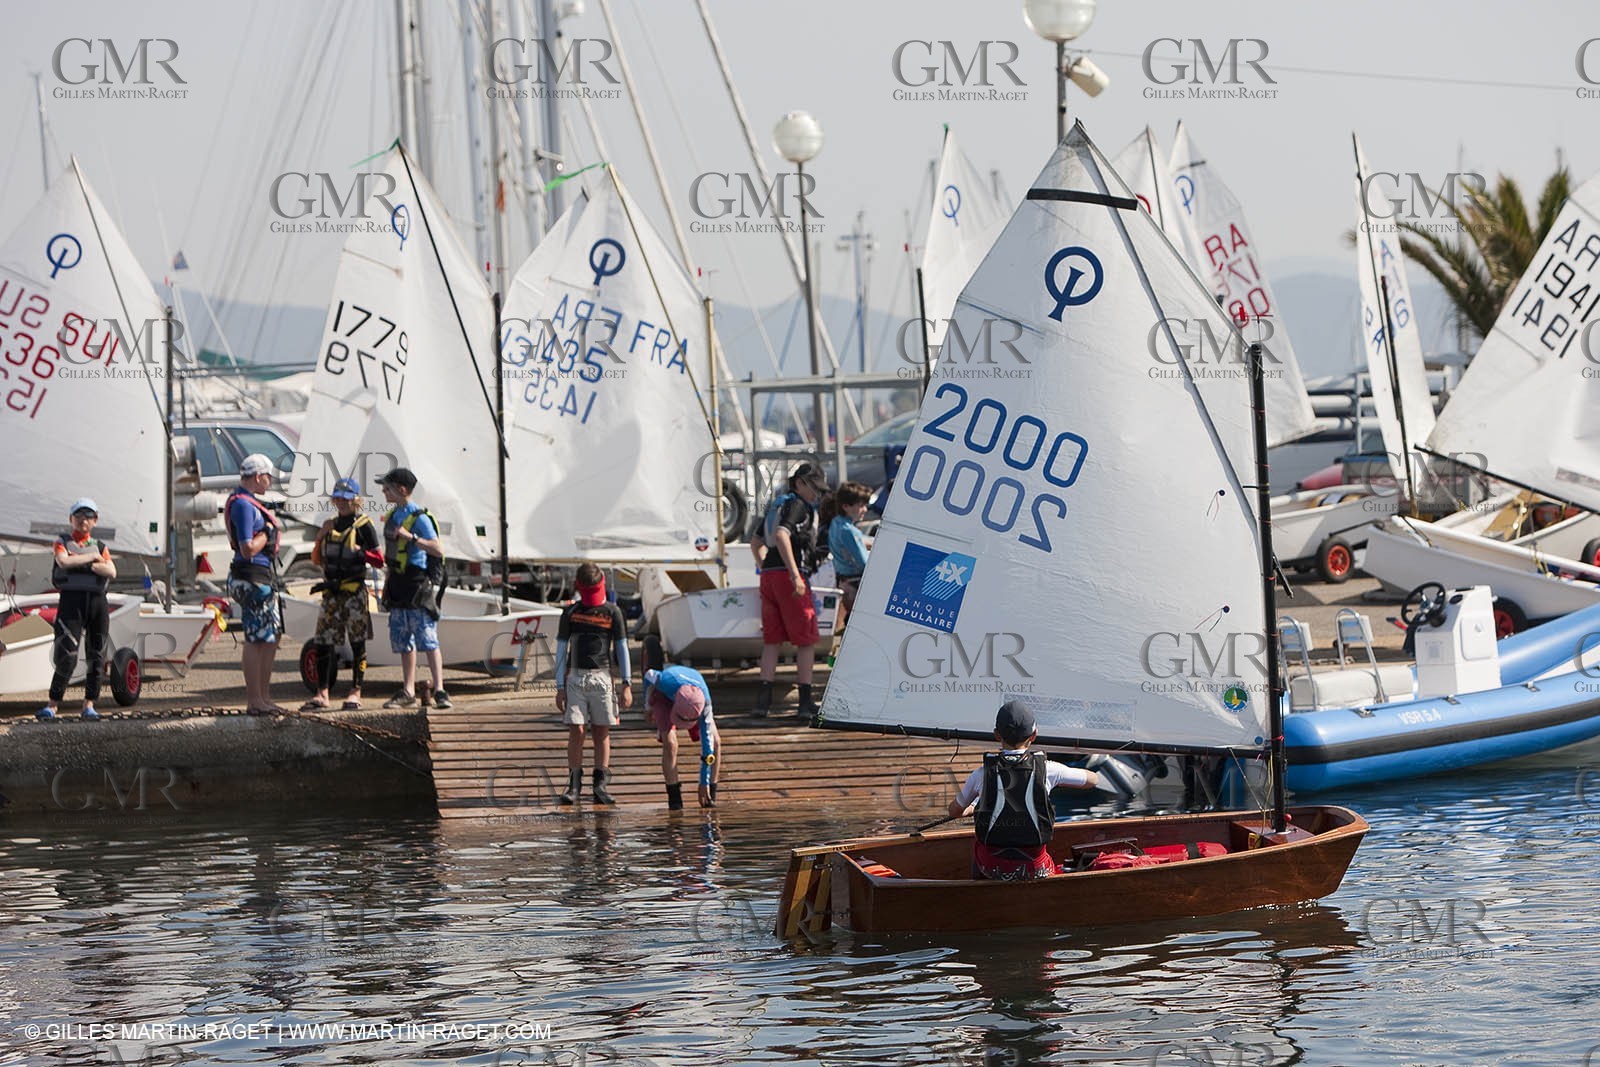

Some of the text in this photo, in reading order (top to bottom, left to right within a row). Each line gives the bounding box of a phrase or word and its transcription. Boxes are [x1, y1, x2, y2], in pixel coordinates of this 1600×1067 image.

[1534, 253, 1600, 323] 1941
[56, 312, 120, 367] SUI
[629, 320, 688, 375] FRA
[922, 382, 1089, 489] 2000
[889, 604, 953, 629] POPULAIRE
[892, 594, 955, 619] BANQUE
